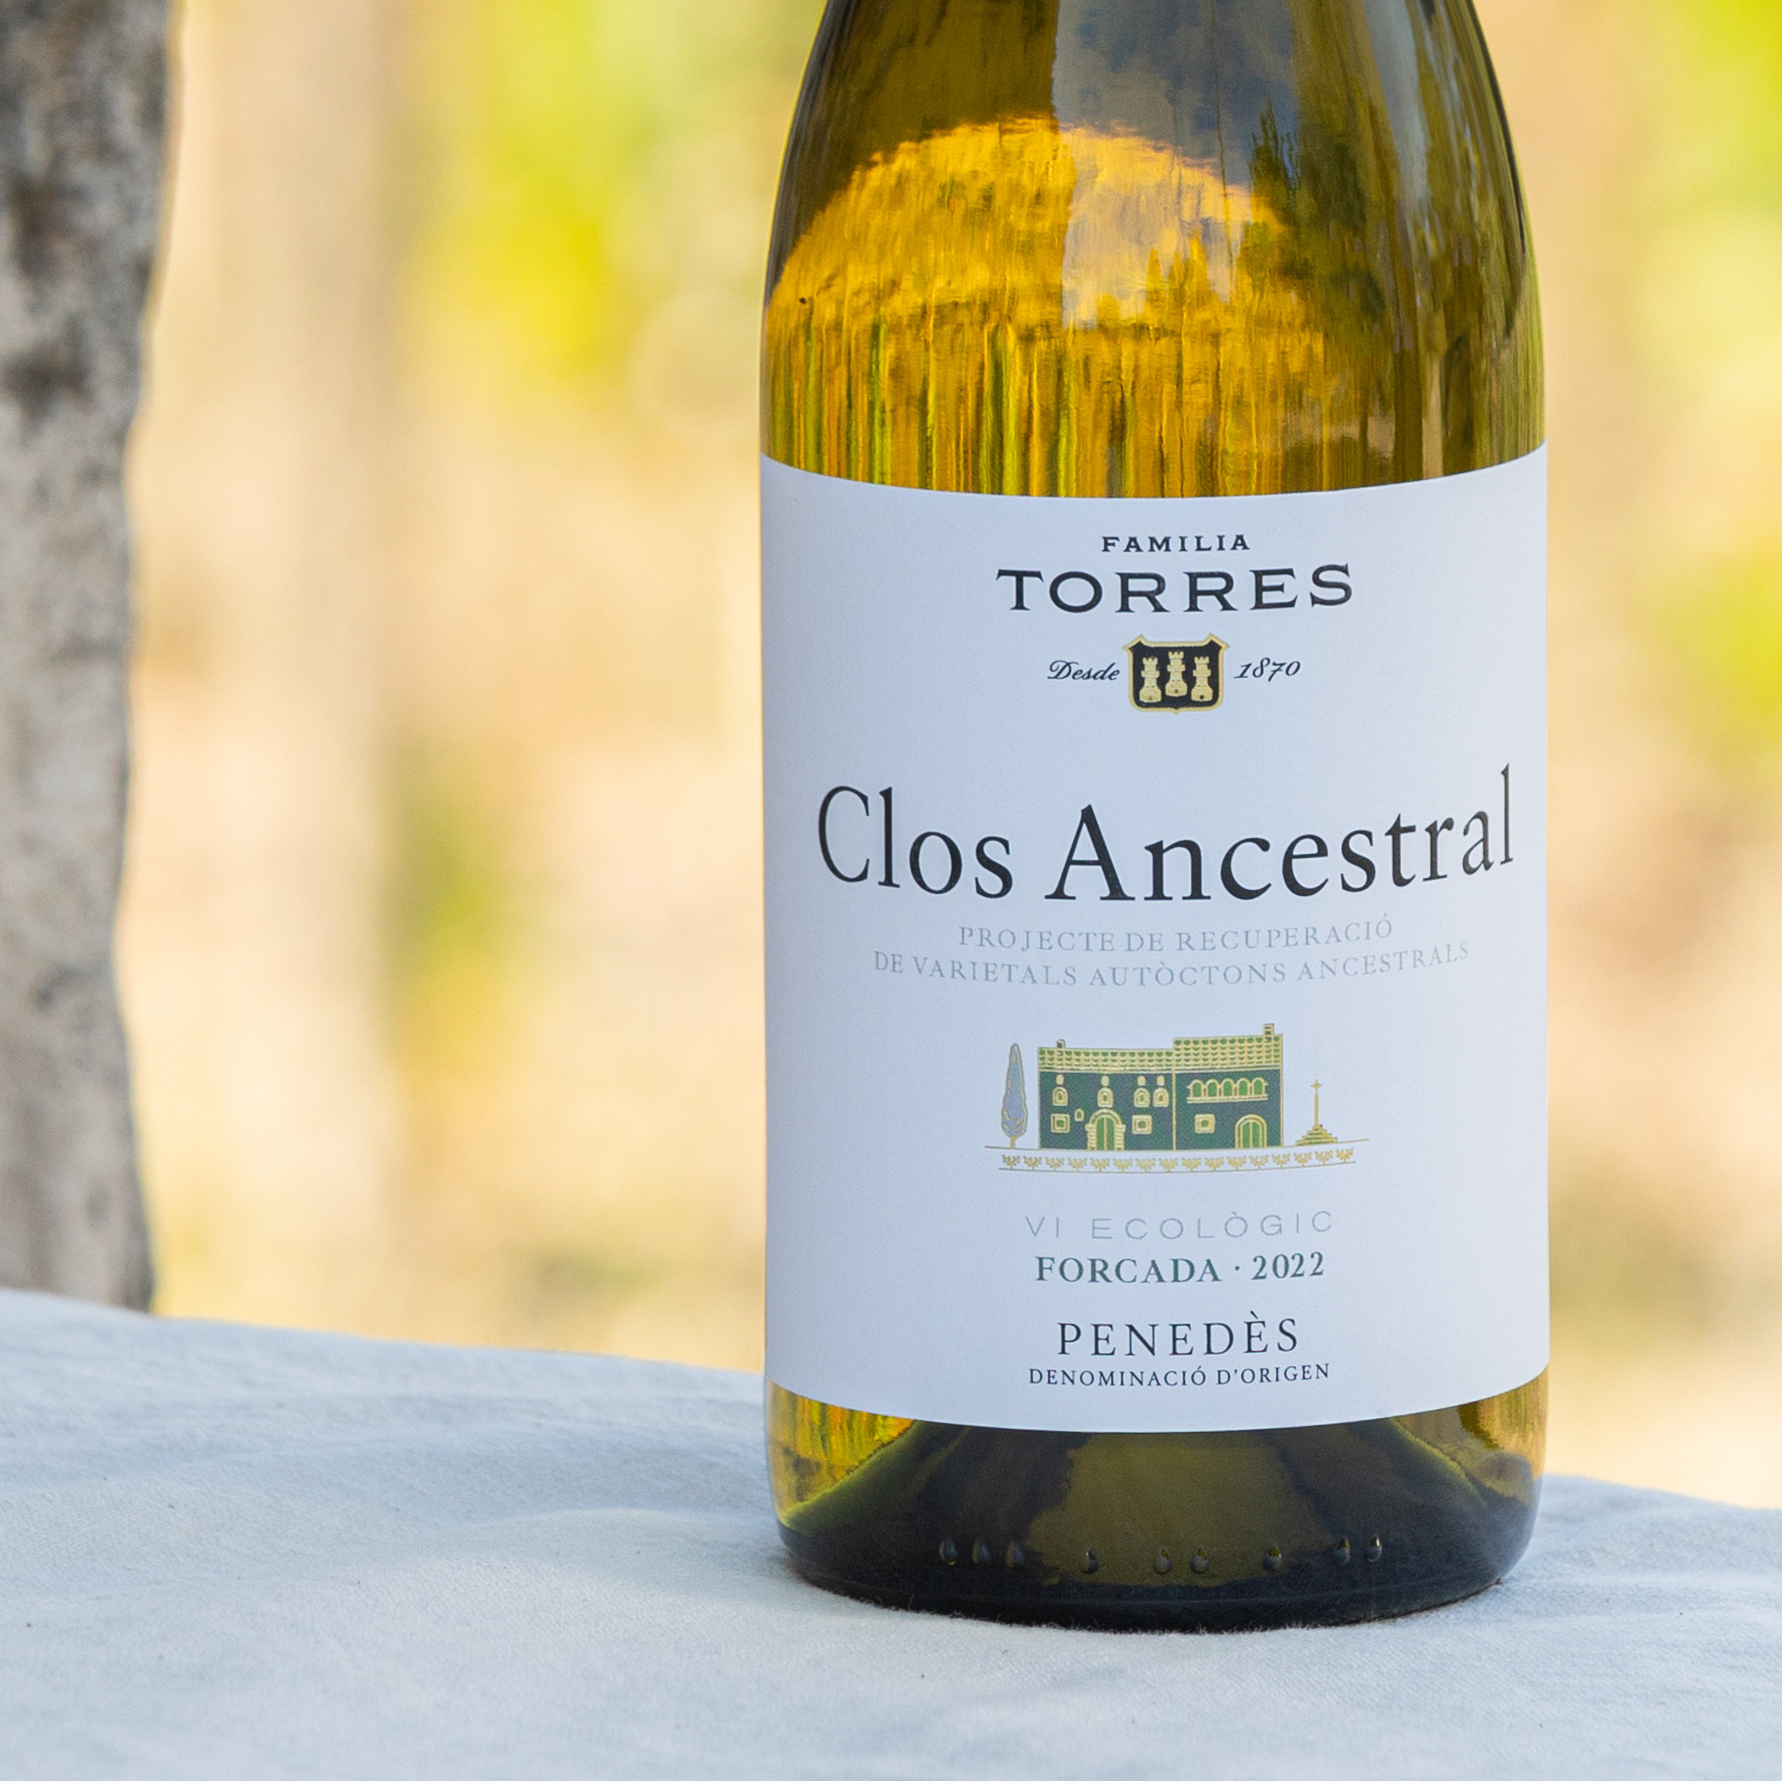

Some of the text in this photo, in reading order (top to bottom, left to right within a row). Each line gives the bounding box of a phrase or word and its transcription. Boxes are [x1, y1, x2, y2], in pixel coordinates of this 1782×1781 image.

[1101, 534, 1251, 553] FAMILIA
[996, 563, 1353, 613] TORRES
[1047, 657, 1301, 682] Desde 1870
[819, 762, 1514, 902] Clos Ancestral
[959, 913, 1393, 953] PROJECTE DE RECUPERACIÓ
[873, 940, 1469, 987] DE VARIETALS AUTÒCTONS ANCESTRALS
[1025, 1210, 1333, 1241] VI ECOLÒGIC
[1034, 1256, 1222, 1284] FORCADA
[1252, 1251, 1325, 1281] 2022
[1058, 1311, 1299, 1357] PENEDÈS
[1029, 1363, 1330, 1388] DENOMINACIÓ D'ORIGEN
